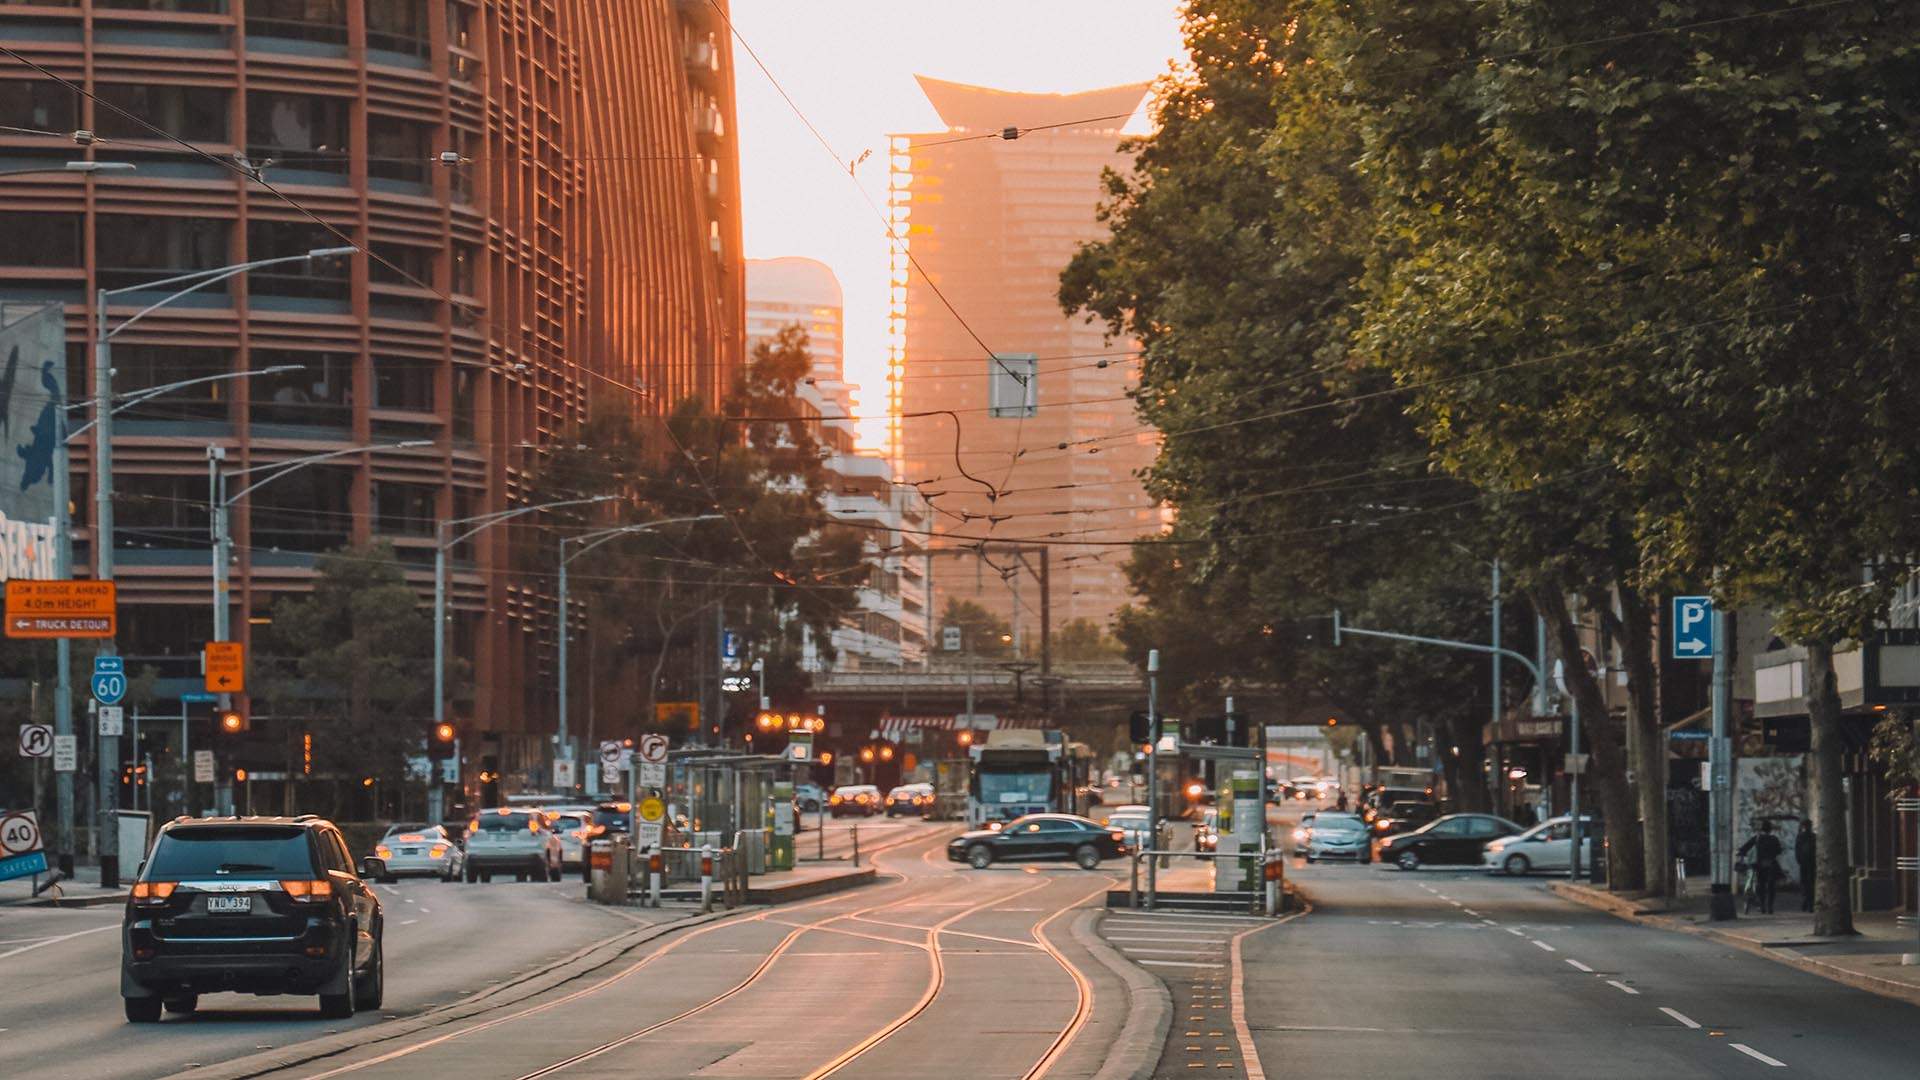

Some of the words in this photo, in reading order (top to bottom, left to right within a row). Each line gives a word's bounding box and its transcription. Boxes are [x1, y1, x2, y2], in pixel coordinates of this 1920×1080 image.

[12, 585, 32, 594] LOW
[37, 585, 70, 594] BRIDGE
[75, 585, 108, 594] AHEAD
[24, 599, 54, 609] 4.0m
[58, 599, 97, 609] HEIGHT
[1682, 603, 1704, 633] P
[35, 620, 66, 629] TRUCK
[70, 620, 108, 629] DETOUR
[98, 677, 120, 696] 60
[7, 825, 31, 843] 40
[2, 860, 38, 873] SAFELY
[233, 897, 249, 908] 394
